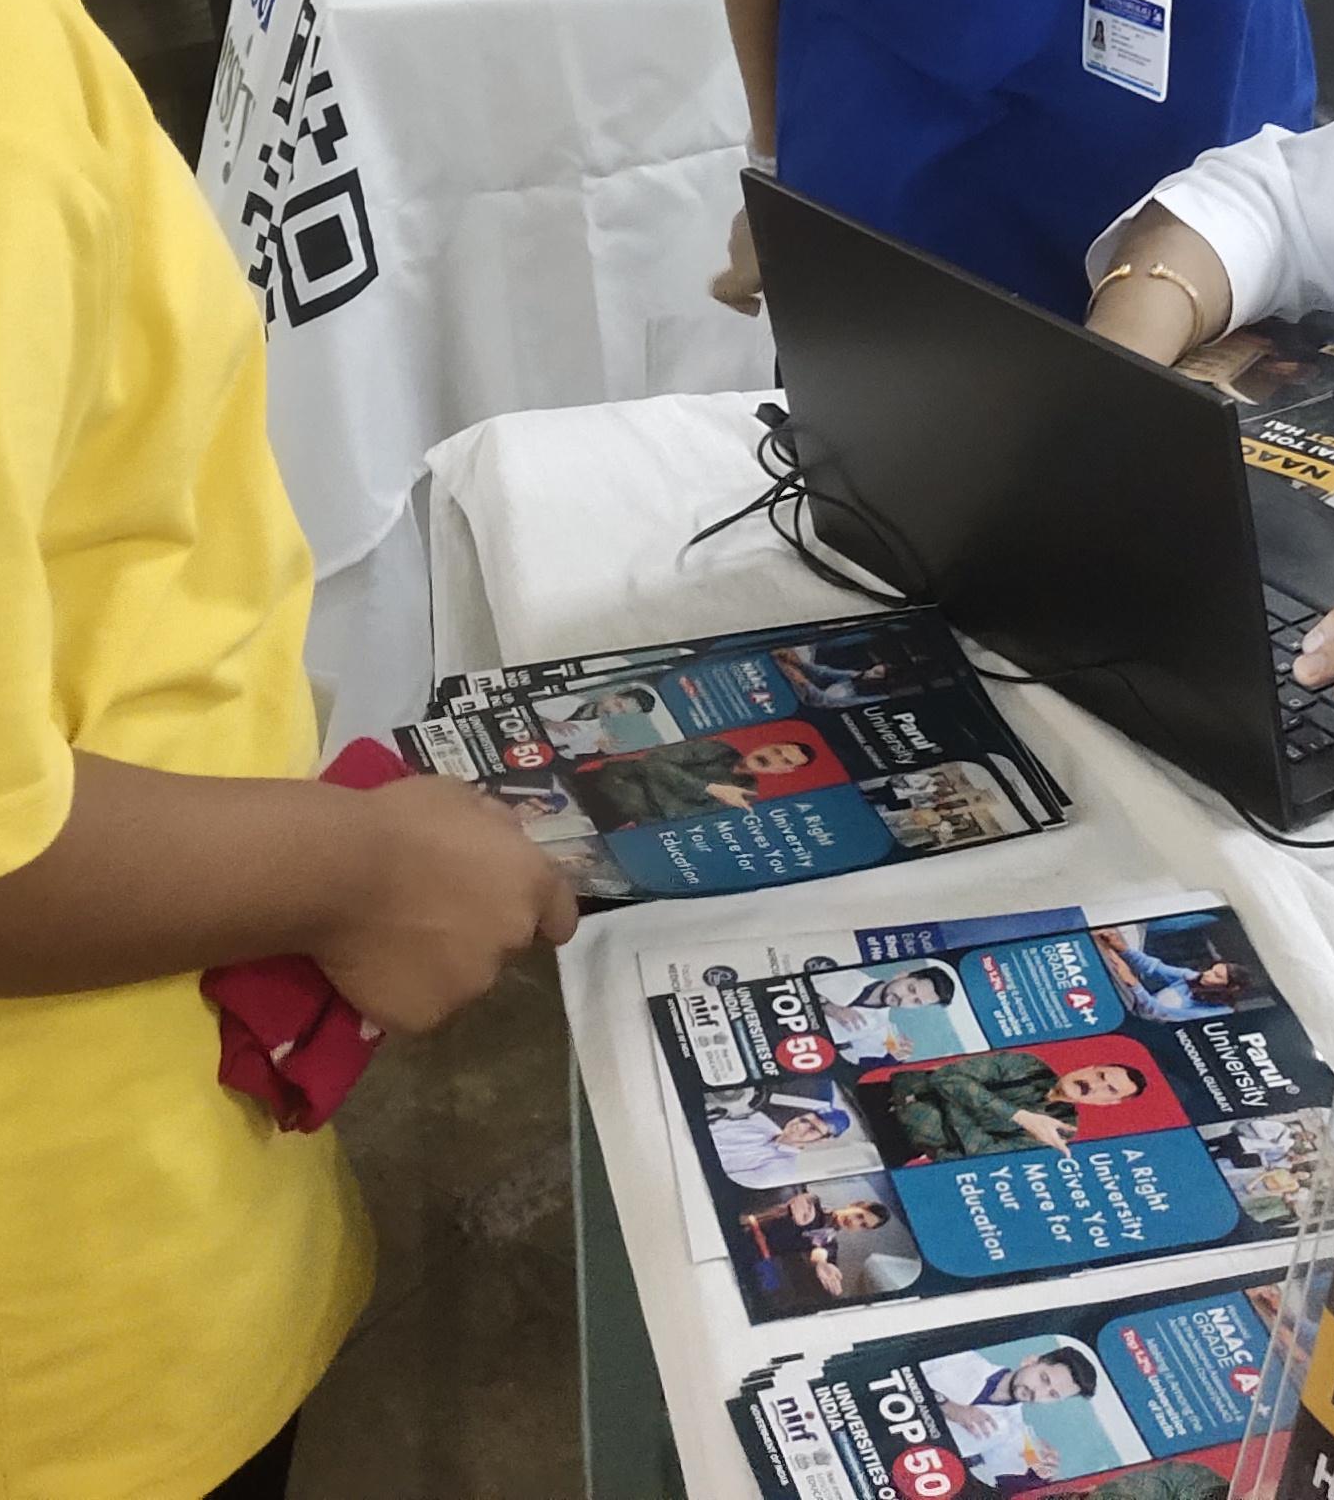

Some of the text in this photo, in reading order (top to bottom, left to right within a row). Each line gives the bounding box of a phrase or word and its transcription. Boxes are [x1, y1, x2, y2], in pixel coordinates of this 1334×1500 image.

[1259, 431, 1305, 450] TOH
[1264, 420, 1306, 437] HAI
[494, 706, 531, 742] TOP
[863, 705, 909, 765] University
[893, 711, 935, 752] Parul
[512, 743, 544, 768] 50
[685, 824, 713, 853] Your
[715, 820, 756, 872] More for
[742, 814, 788, 875] Gives You
[769, 808, 815, 868] University
[794, 802, 835, 847] A Right
[658, 830, 700, 885] Education
[1040, 944, 1071, 989] GRADE
[1054, 941, 1088, 987] NAAC
[688, 992, 724, 1029] nirf
[720, 988, 742, 1020] INDIA
[763, 979, 824, 1071] TOP 50
[1067, 990, 1102, 1026] A++
[734, 986, 773, 1060] UNIVERSITIES
[760, 1060, 780, 1077] OF
[1202, 1022, 1270, 1107] University
[1238, 1032, 1292, 1089] Parul
[1203, 1076, 1234, 1113] GUJARAT
[989, 1165, 1020, 1211] Your
[1023, 1163, 1072, 1243] More for
[1057, 1157, 1111, 1248] Gives You
[1089, 1153, 1145, 1241] University
[1122, 1149, 1170, 1212] A Right
[956, 1172, 1005, 1261] Education
[1192, 1311, 1236, 1369] GRADE
[1206, 1307, 1254, 1364] NAAC
[777, 1396, 819, 1442] nirf
[813, 1386, 845, 1431] INDIA
[831, 1381, 889, 1486] UNIVERSITIES
[869, 1369, 951, 1497] TOP 50
